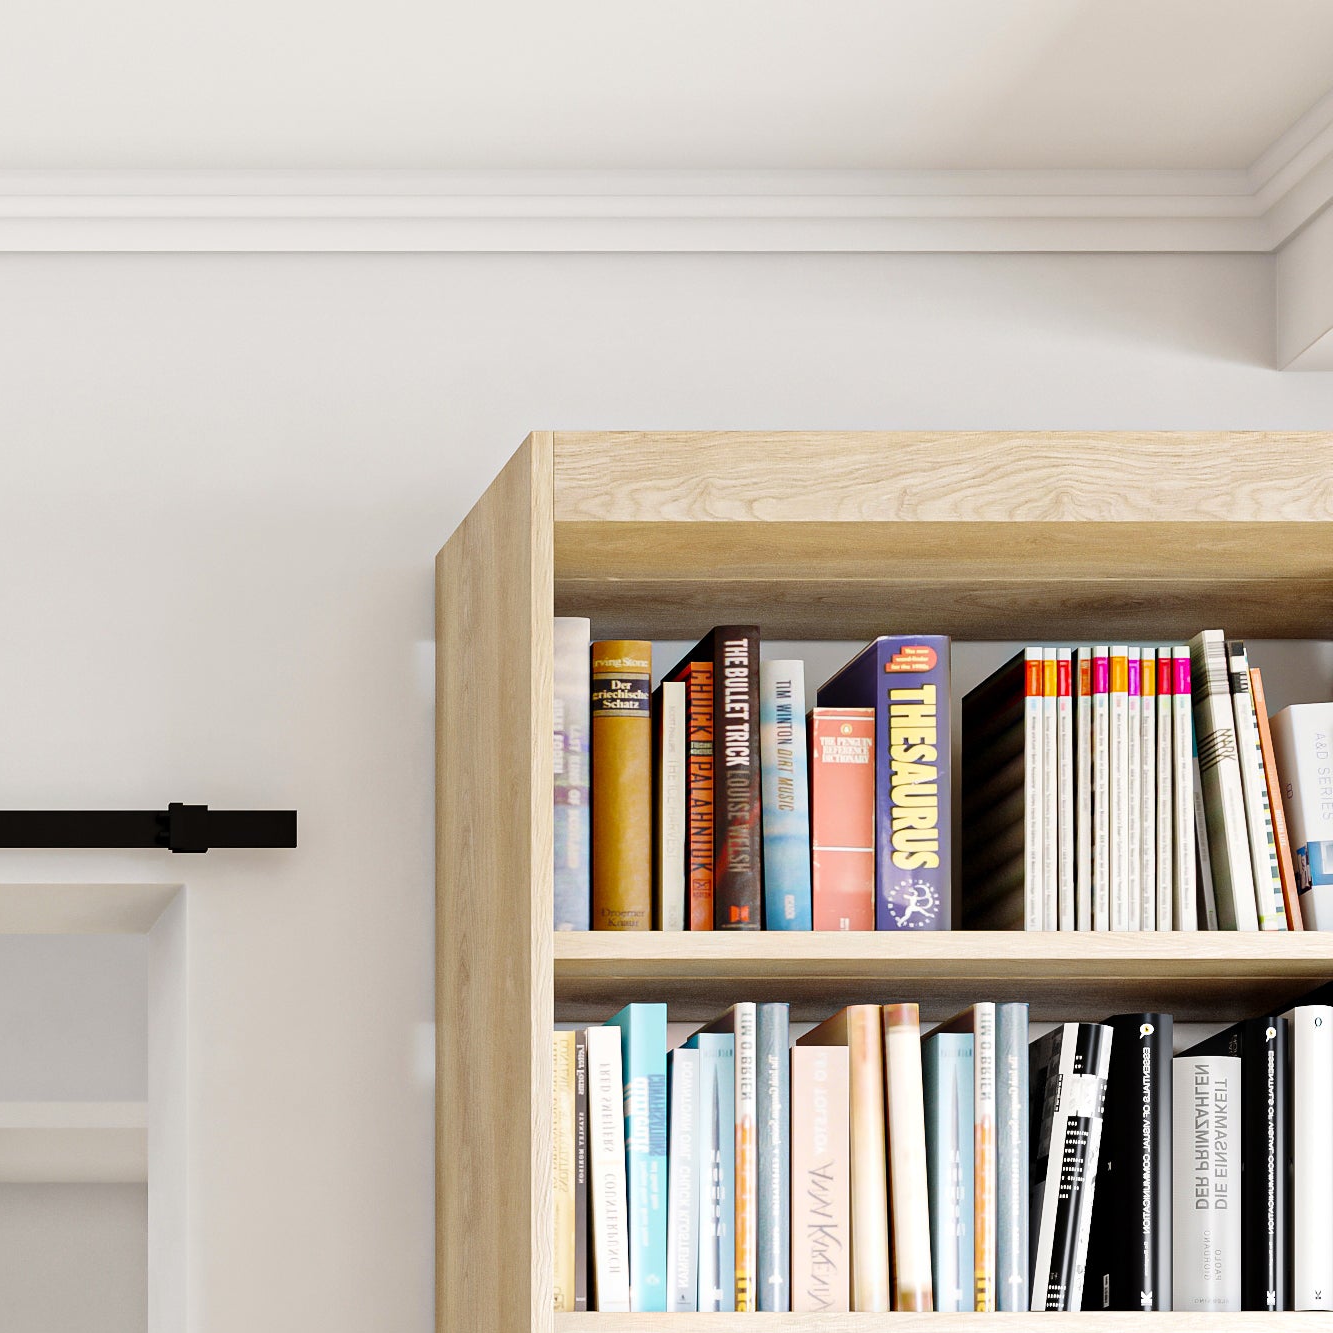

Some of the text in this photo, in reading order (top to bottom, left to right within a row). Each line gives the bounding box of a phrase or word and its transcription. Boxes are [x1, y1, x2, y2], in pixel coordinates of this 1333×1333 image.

[602, 698, 640, 710] Schatz
[611, 679, 633, 691] Der
[723, 638, 751, 767] THE BULLET TRICK
[774, 679, 794, 747] TIM WINTON
[690, 668, 713, 874] CHUCK PALAHNIUK
[777, 748, 795, 812] DIRT MUSIC
[889, 683, 941, 872] THESAURUS
[727, 769, 752, 873] LOUISE WELSH
